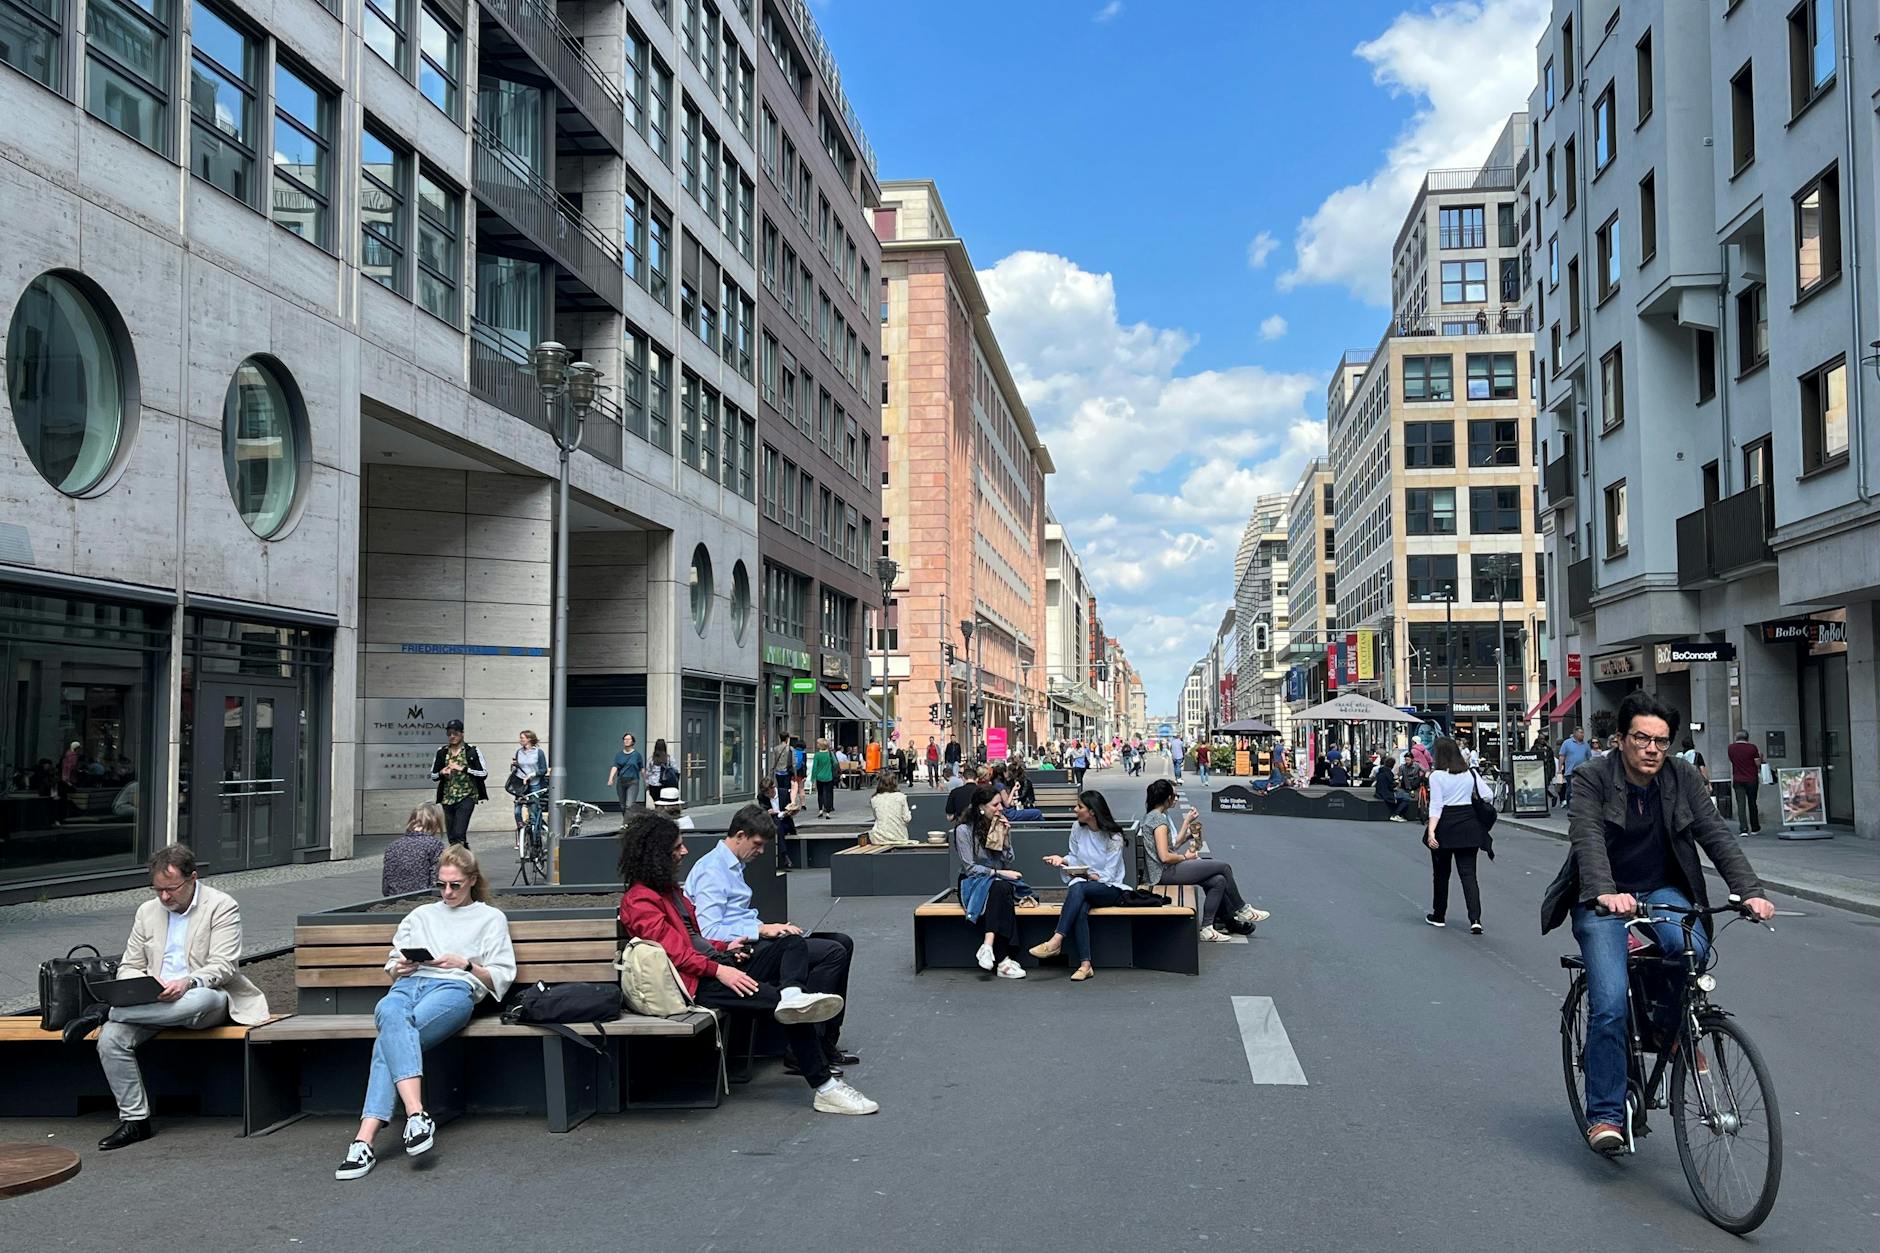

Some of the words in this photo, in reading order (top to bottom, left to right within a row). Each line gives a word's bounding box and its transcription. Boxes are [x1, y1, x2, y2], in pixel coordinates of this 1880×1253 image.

[1347, 645, 1357, 675] REWE
[1672, 651, 1717, 661] BoConcept
[1453, 703, 1490, 712] ittenwerk
